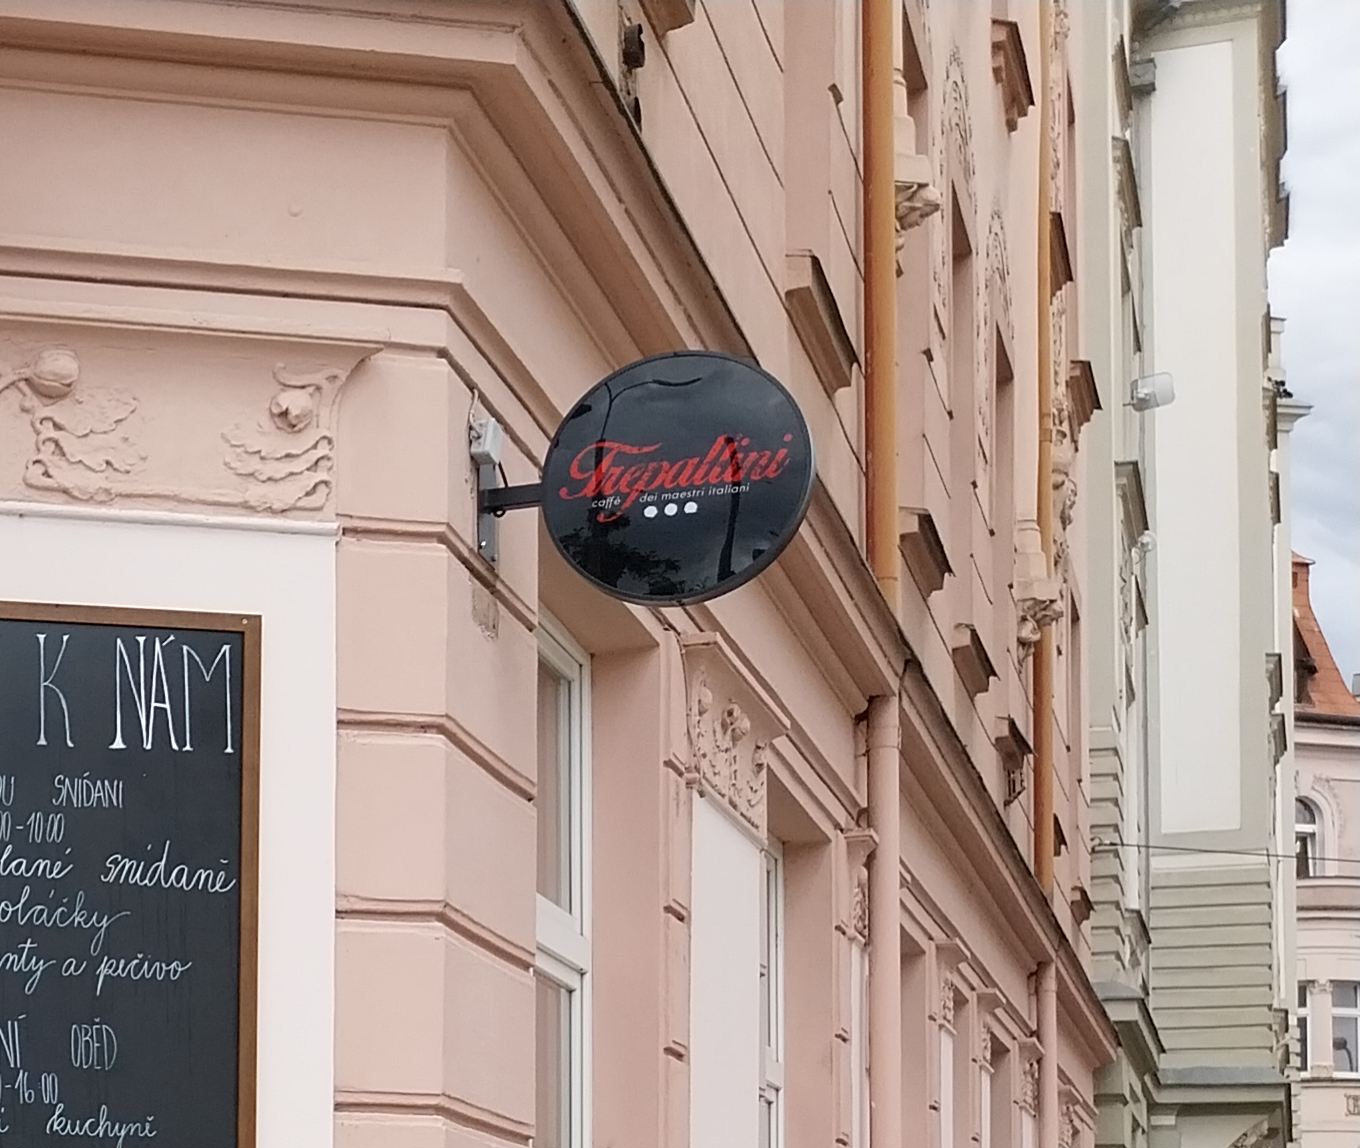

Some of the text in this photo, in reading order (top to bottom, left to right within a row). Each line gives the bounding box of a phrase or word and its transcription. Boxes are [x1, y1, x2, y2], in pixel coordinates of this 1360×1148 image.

[591, 482, 750, 510] caffè dei maestri italiani
[36, 633, 75, 748] K
[109, 633, 235, 754] NÁM
[101, 841, 237, 893] snídaně
[62, 954, 87, 976] a
[96, 952, 192, 996] pečivo
[70, 1017, 118, 1071] OBĚD
